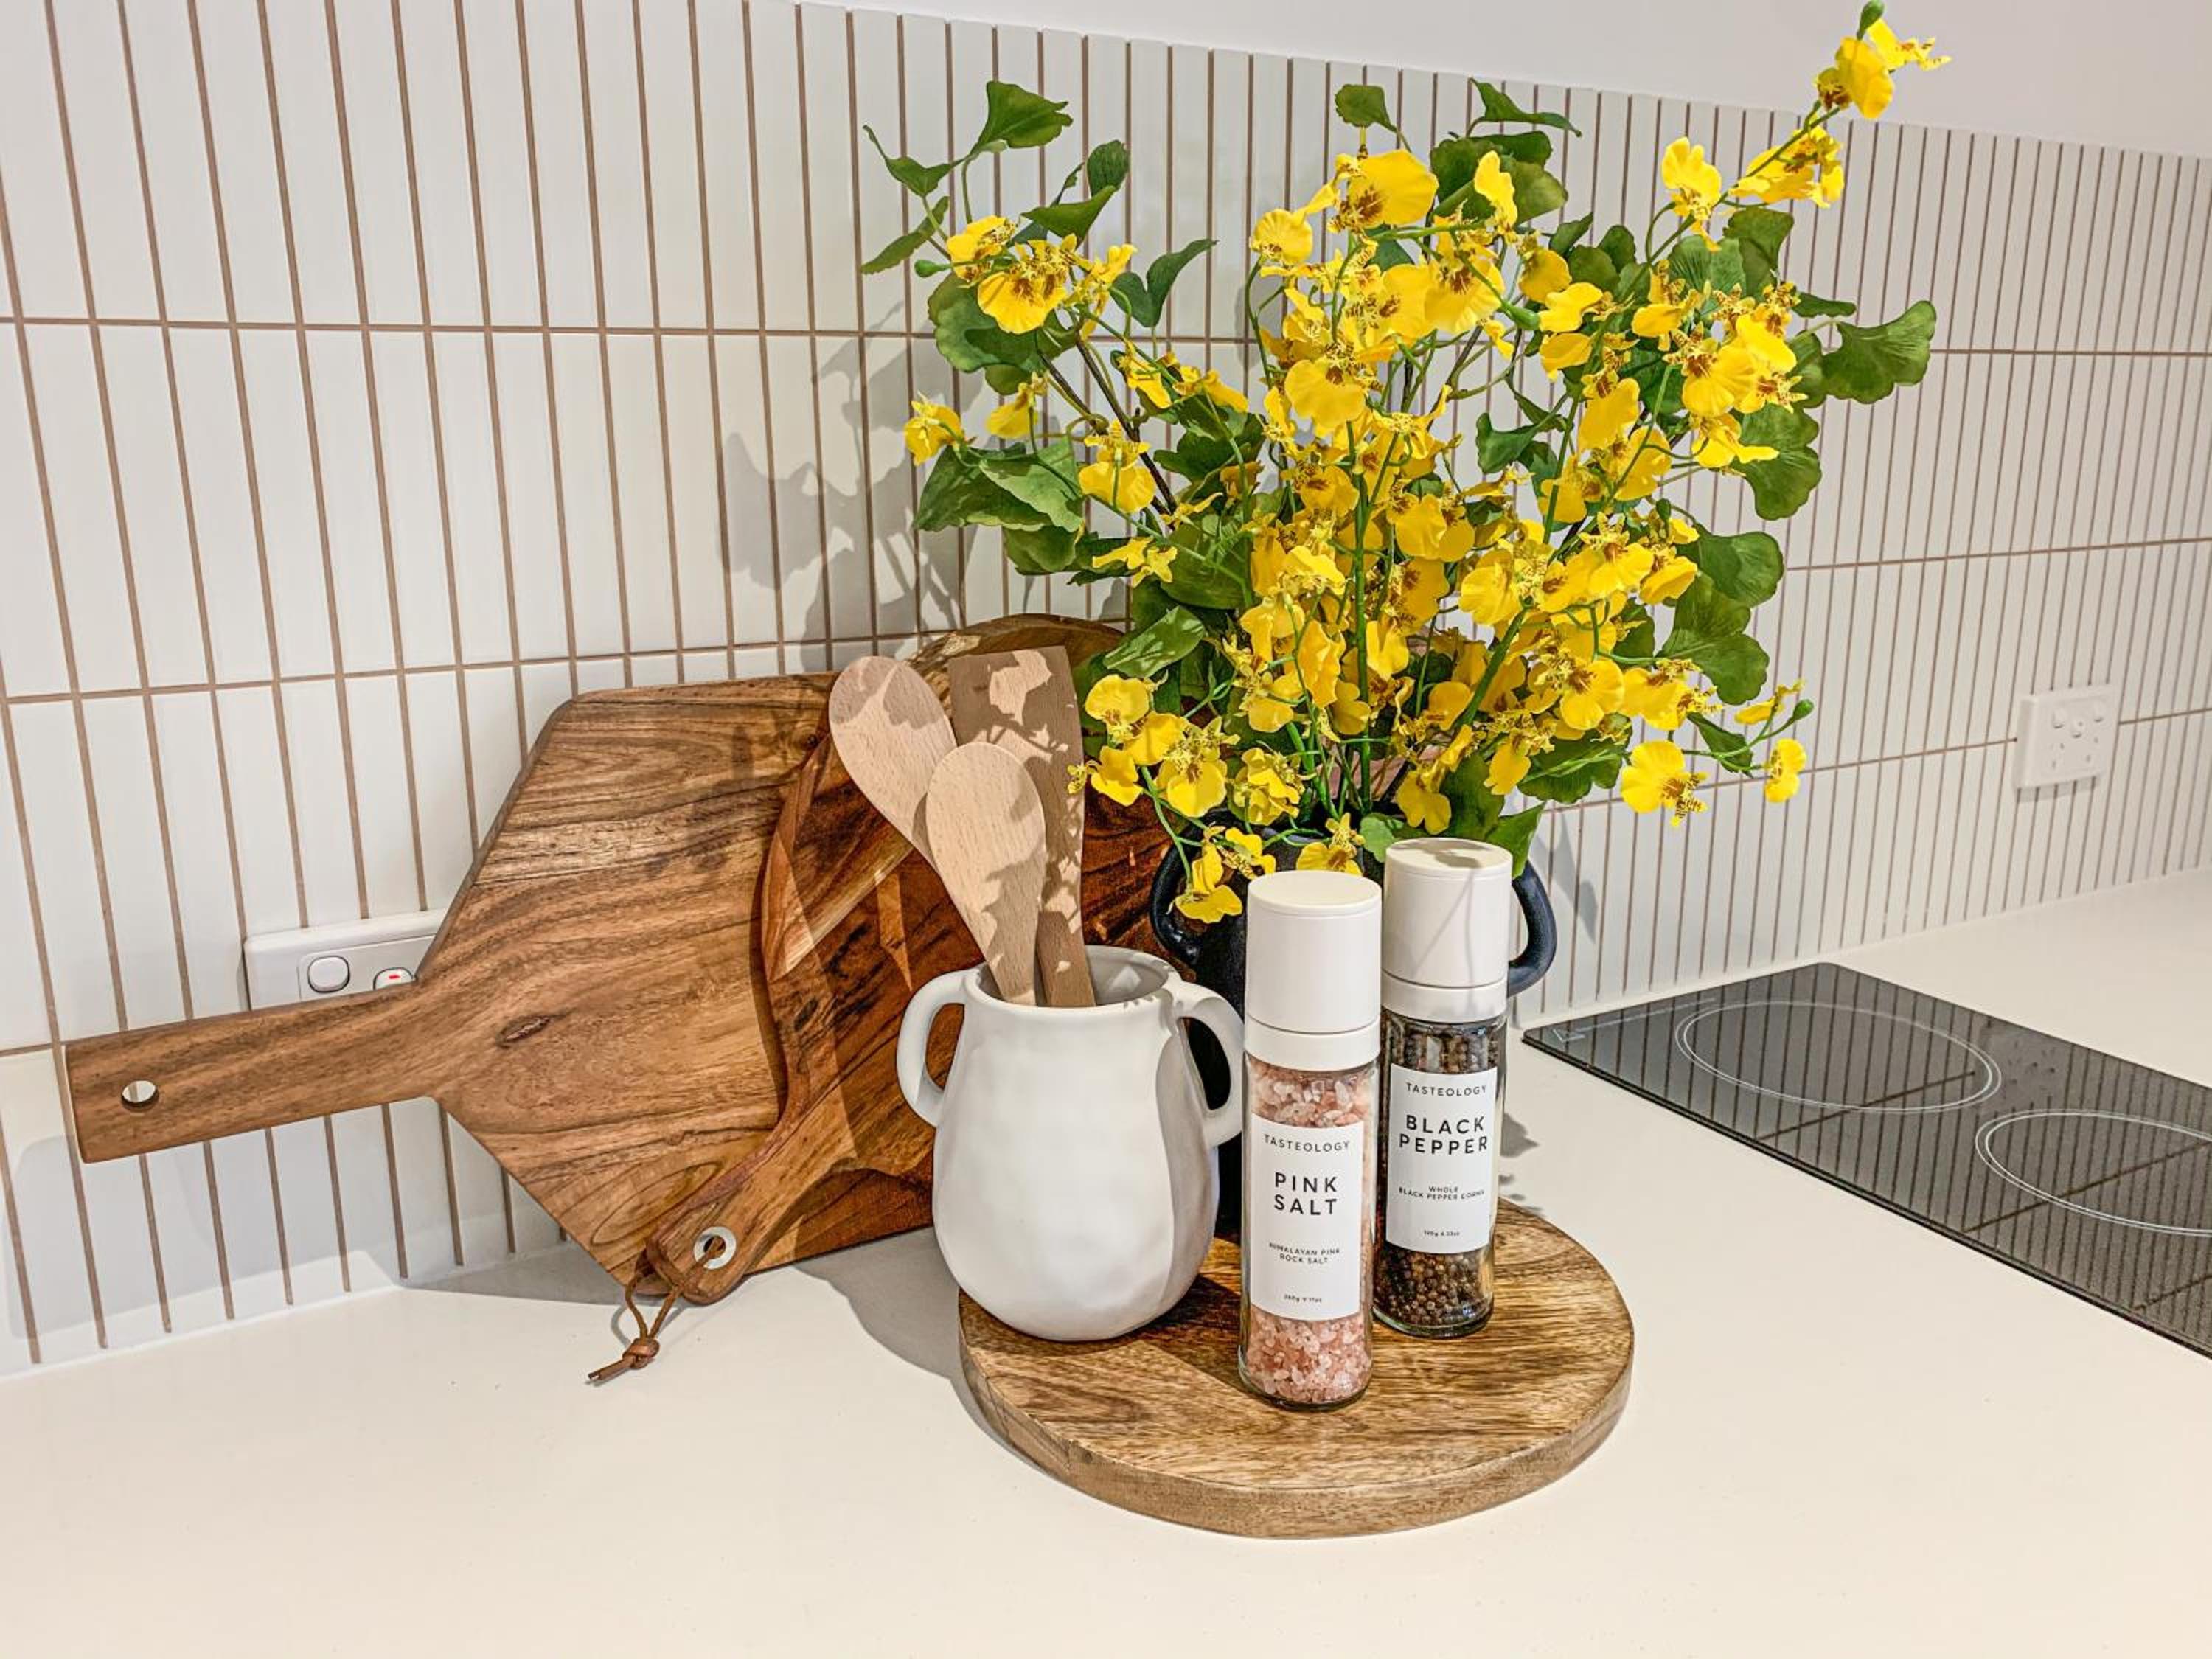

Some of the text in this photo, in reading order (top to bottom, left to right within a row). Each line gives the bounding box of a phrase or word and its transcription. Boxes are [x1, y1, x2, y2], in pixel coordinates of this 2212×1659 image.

[1406, 1082, 1487, 1096] TASTEOLOGY
[1406, 1114, 1485, 1135] BLACK
[1264, 1133, 1350, 1152] TASTEOLOGY
[1399, 1133, 1488, 1155] PEPPER
[1274, 1172, 1338, 1193] PINK
[1398, 1186, 1424, 1198] BLACK
[1274, 1194, 1338, 1216] SALT
[1269, 1242, 1340, 1256] HIMALAYAN PINK
[1280, 1253, 1304, 1263] ROCK
